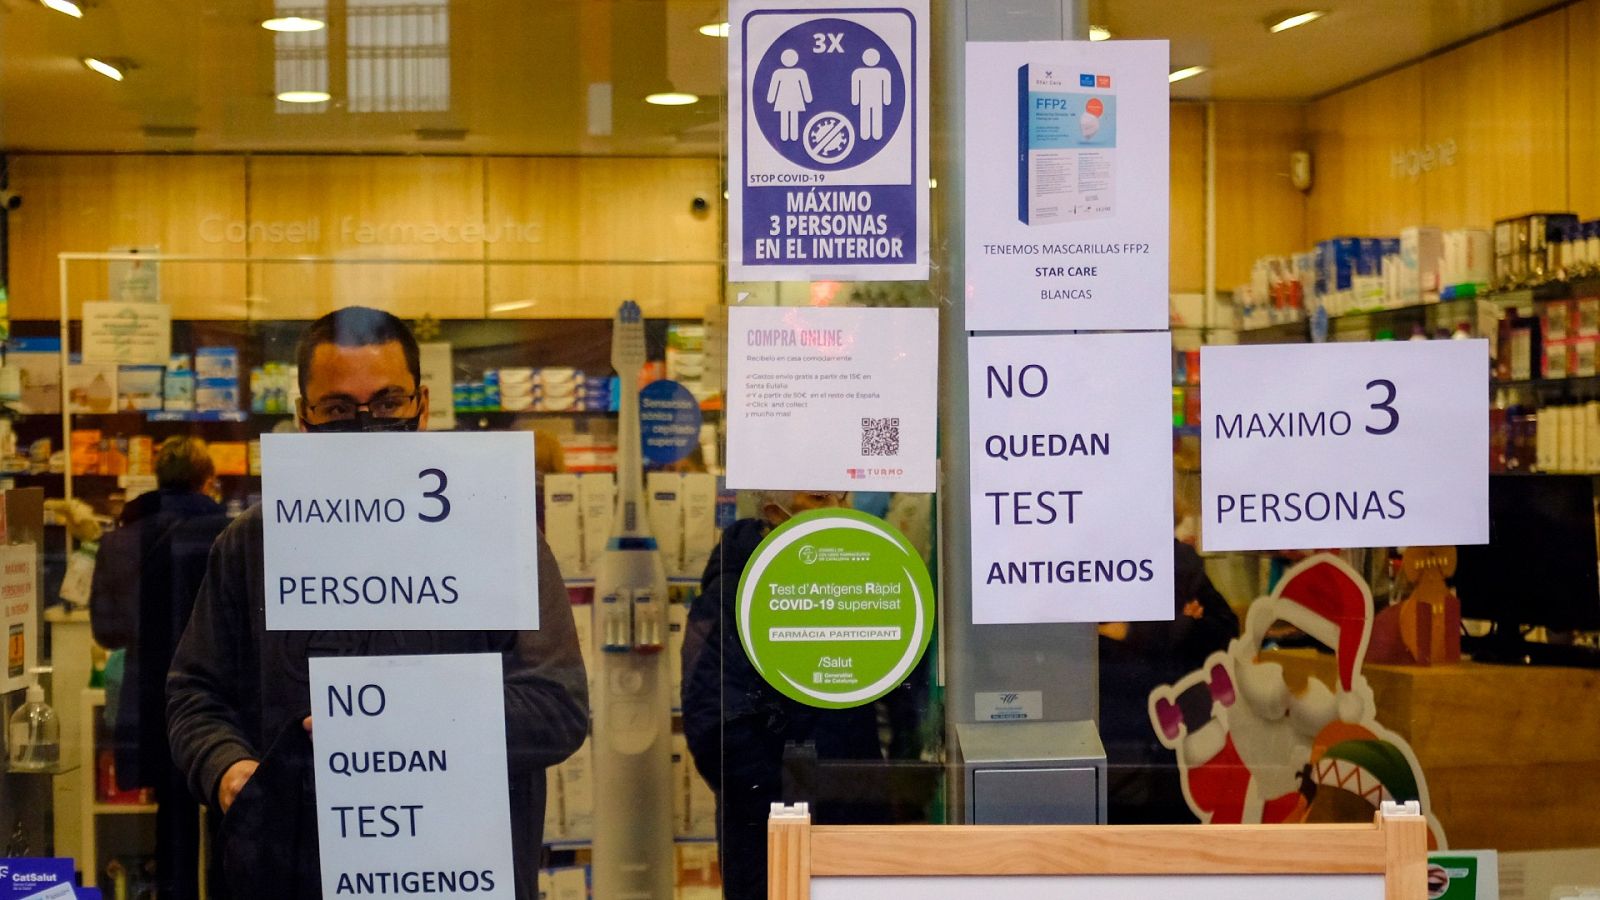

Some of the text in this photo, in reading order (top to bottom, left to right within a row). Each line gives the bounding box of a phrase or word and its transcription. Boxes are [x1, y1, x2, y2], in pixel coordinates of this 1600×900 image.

[813, 33, 844, 53] 3X
[1036, 98, 1067, 110] FFP2
[750, 174, 824, 182] STOP COVID-19
[786, 187, 872, 212] MÁXIMO
[200, 214, 320, 243] Consell
[770, 214, 888, 236] 3 PERSONAS
[756, 237, 904, 259] EN EL INTERIOR
[984, 244, 1150, 254] TENEMOS MASCARILLAS FFP2
[1035, 266, 1098, 277] STAR CARE
[1041, 290, 1092, 300] BLANCAS
[747, 329, 843, 346] COMPRA ONLINE
[986, 364, 1048, 400] NO
[764, 392, 781, 400] partir
[856, 392, 880, 400] España
[1215, 378, 1400, 440] MAXIMO 3
[984, 433, 1110, 462] QUEDAN
[276, 467, 451, 524] MAXIMO 3
[1217, 489, 1406, 524] PERSONAS
[984, 490, 1084, 526] TEST
[986, 558, 1154, 585] ANTIGENOS
[279, 575, 459, 606] PERSONAS
[769, 584, 795, 595] Test
[865, 582, 900, 597] Ràpid
[769, 599, 900, 612] COVID-19 supervisat
[772, 630, 898, 638] FARMÀCIA PARTICIPANT
[818, 657, 852, 668] /Salut
[327, 683, 386, 718] NO
[328, 749, 447, 778] QUEDAN
[330, 804, 424, 839] TEST
[12, 873, 57, 882] CatSalut
[335, 869, 495, 895] ANTIGENOS
